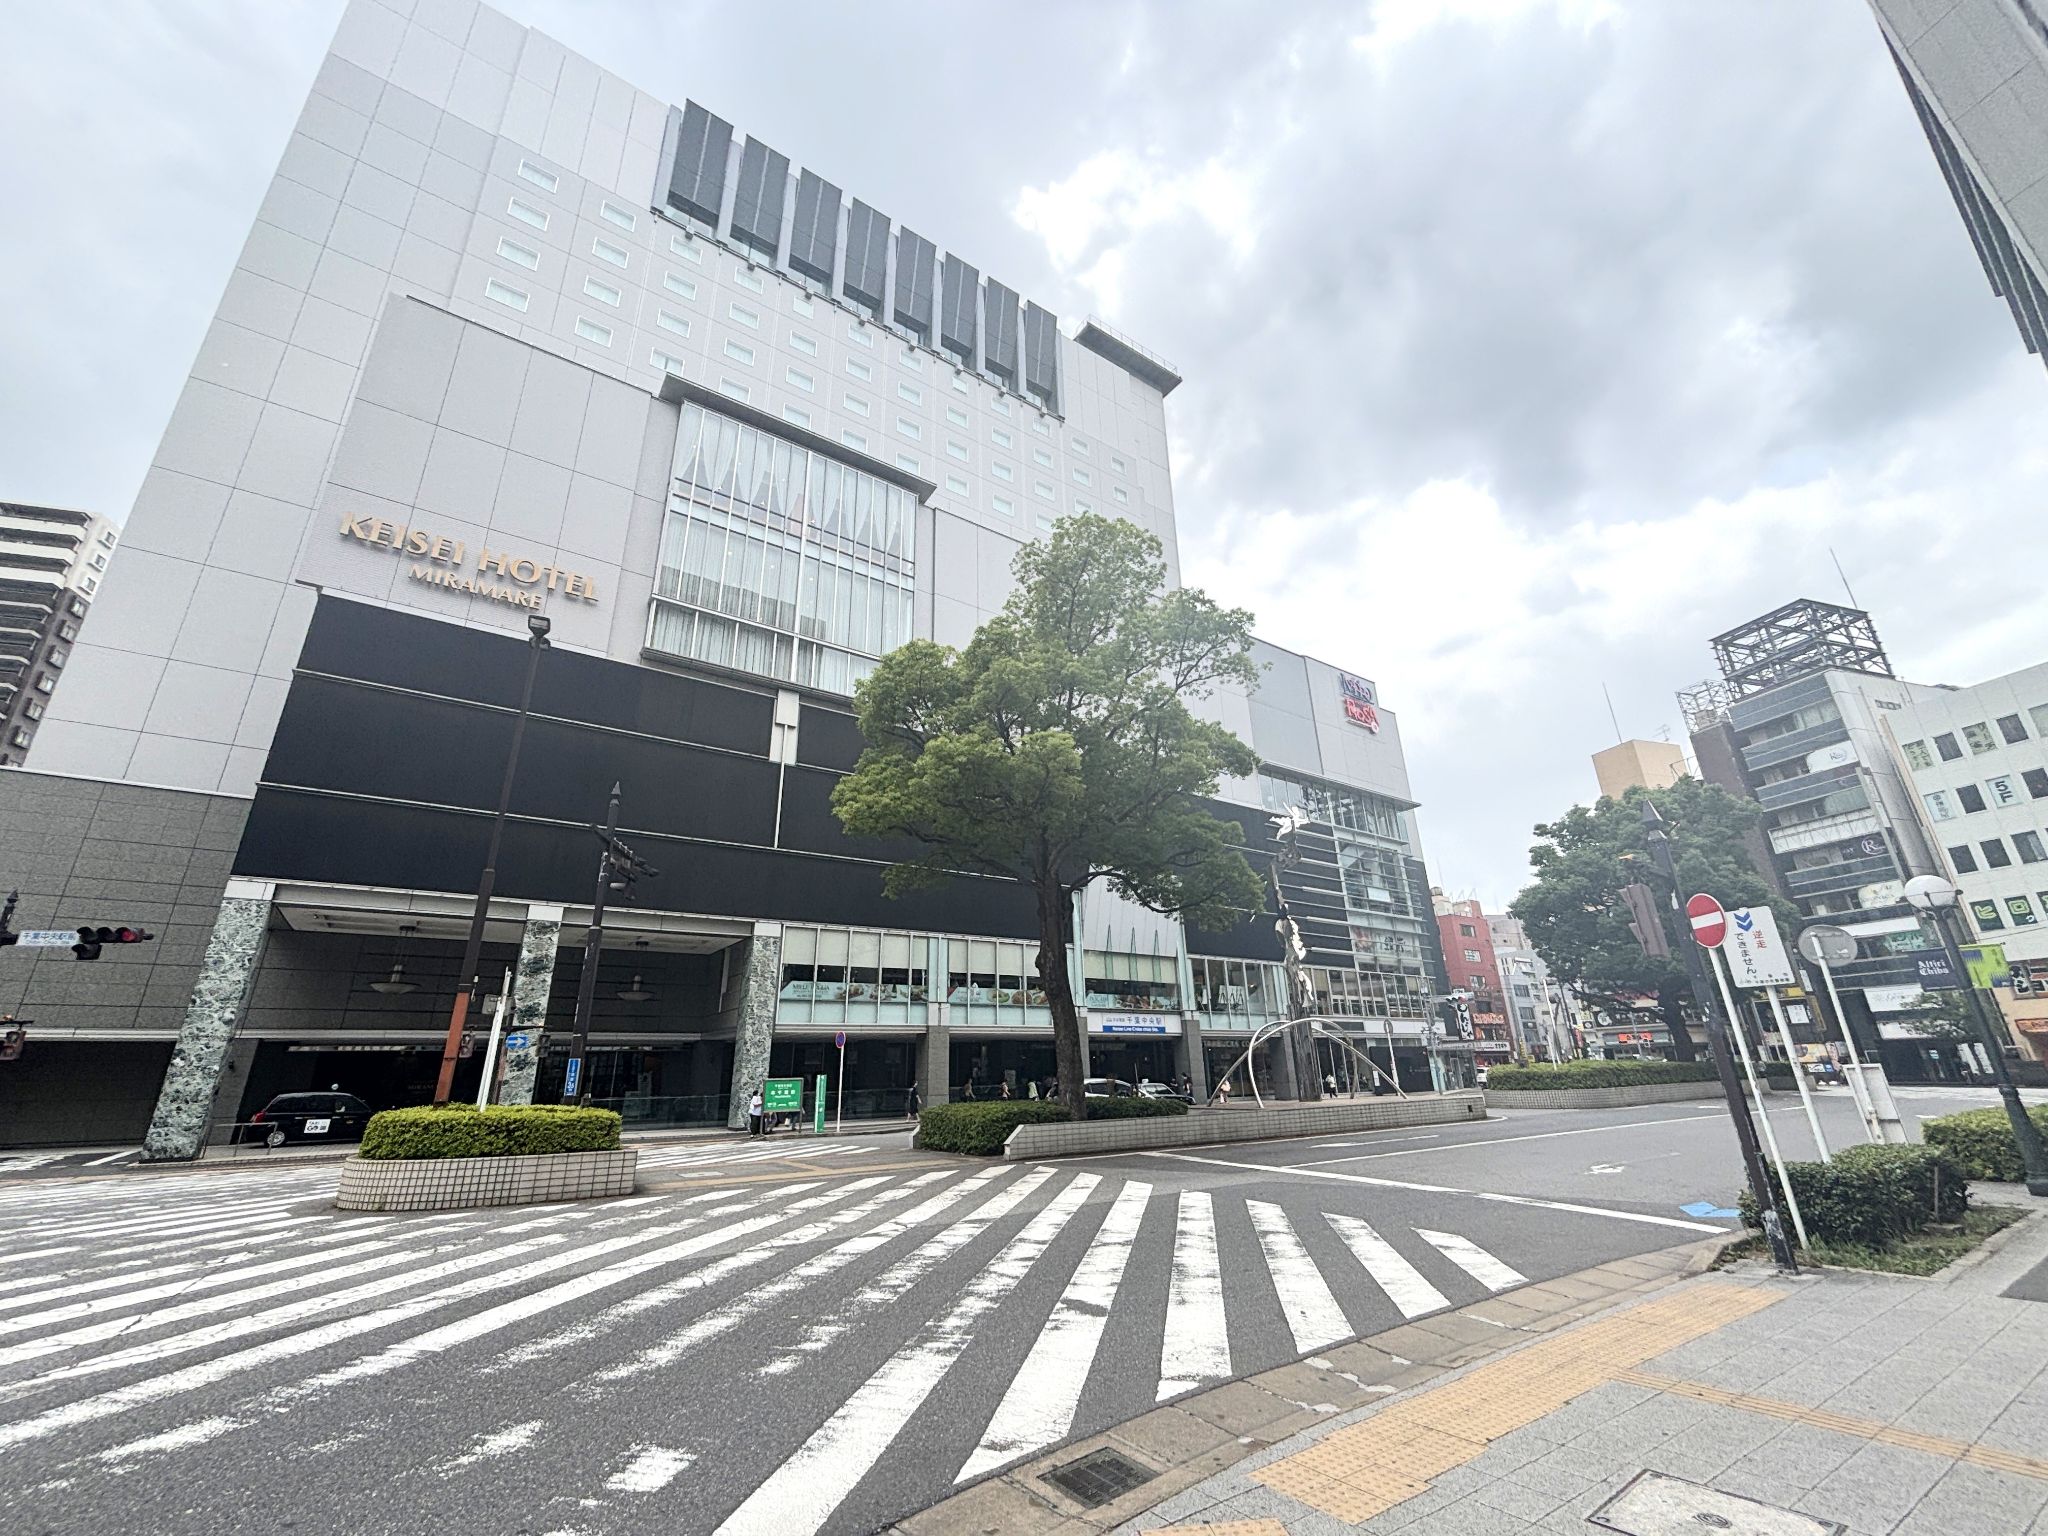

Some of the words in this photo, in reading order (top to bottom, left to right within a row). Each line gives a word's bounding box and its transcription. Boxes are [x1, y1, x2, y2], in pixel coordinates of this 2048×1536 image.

[339, 511, 465, 566] KEISEI
[477, 546, 600, 602] HOTEL
[407, 563, 543, 610] MIRAMARE
[1994, 780, 2013, 803] 5F
[1752, 929, 1767, 949] 逆走
[1919, 967, 1950, 976] Chiba
[1127, 1016, 1162, 1025] 千葉中央駅
